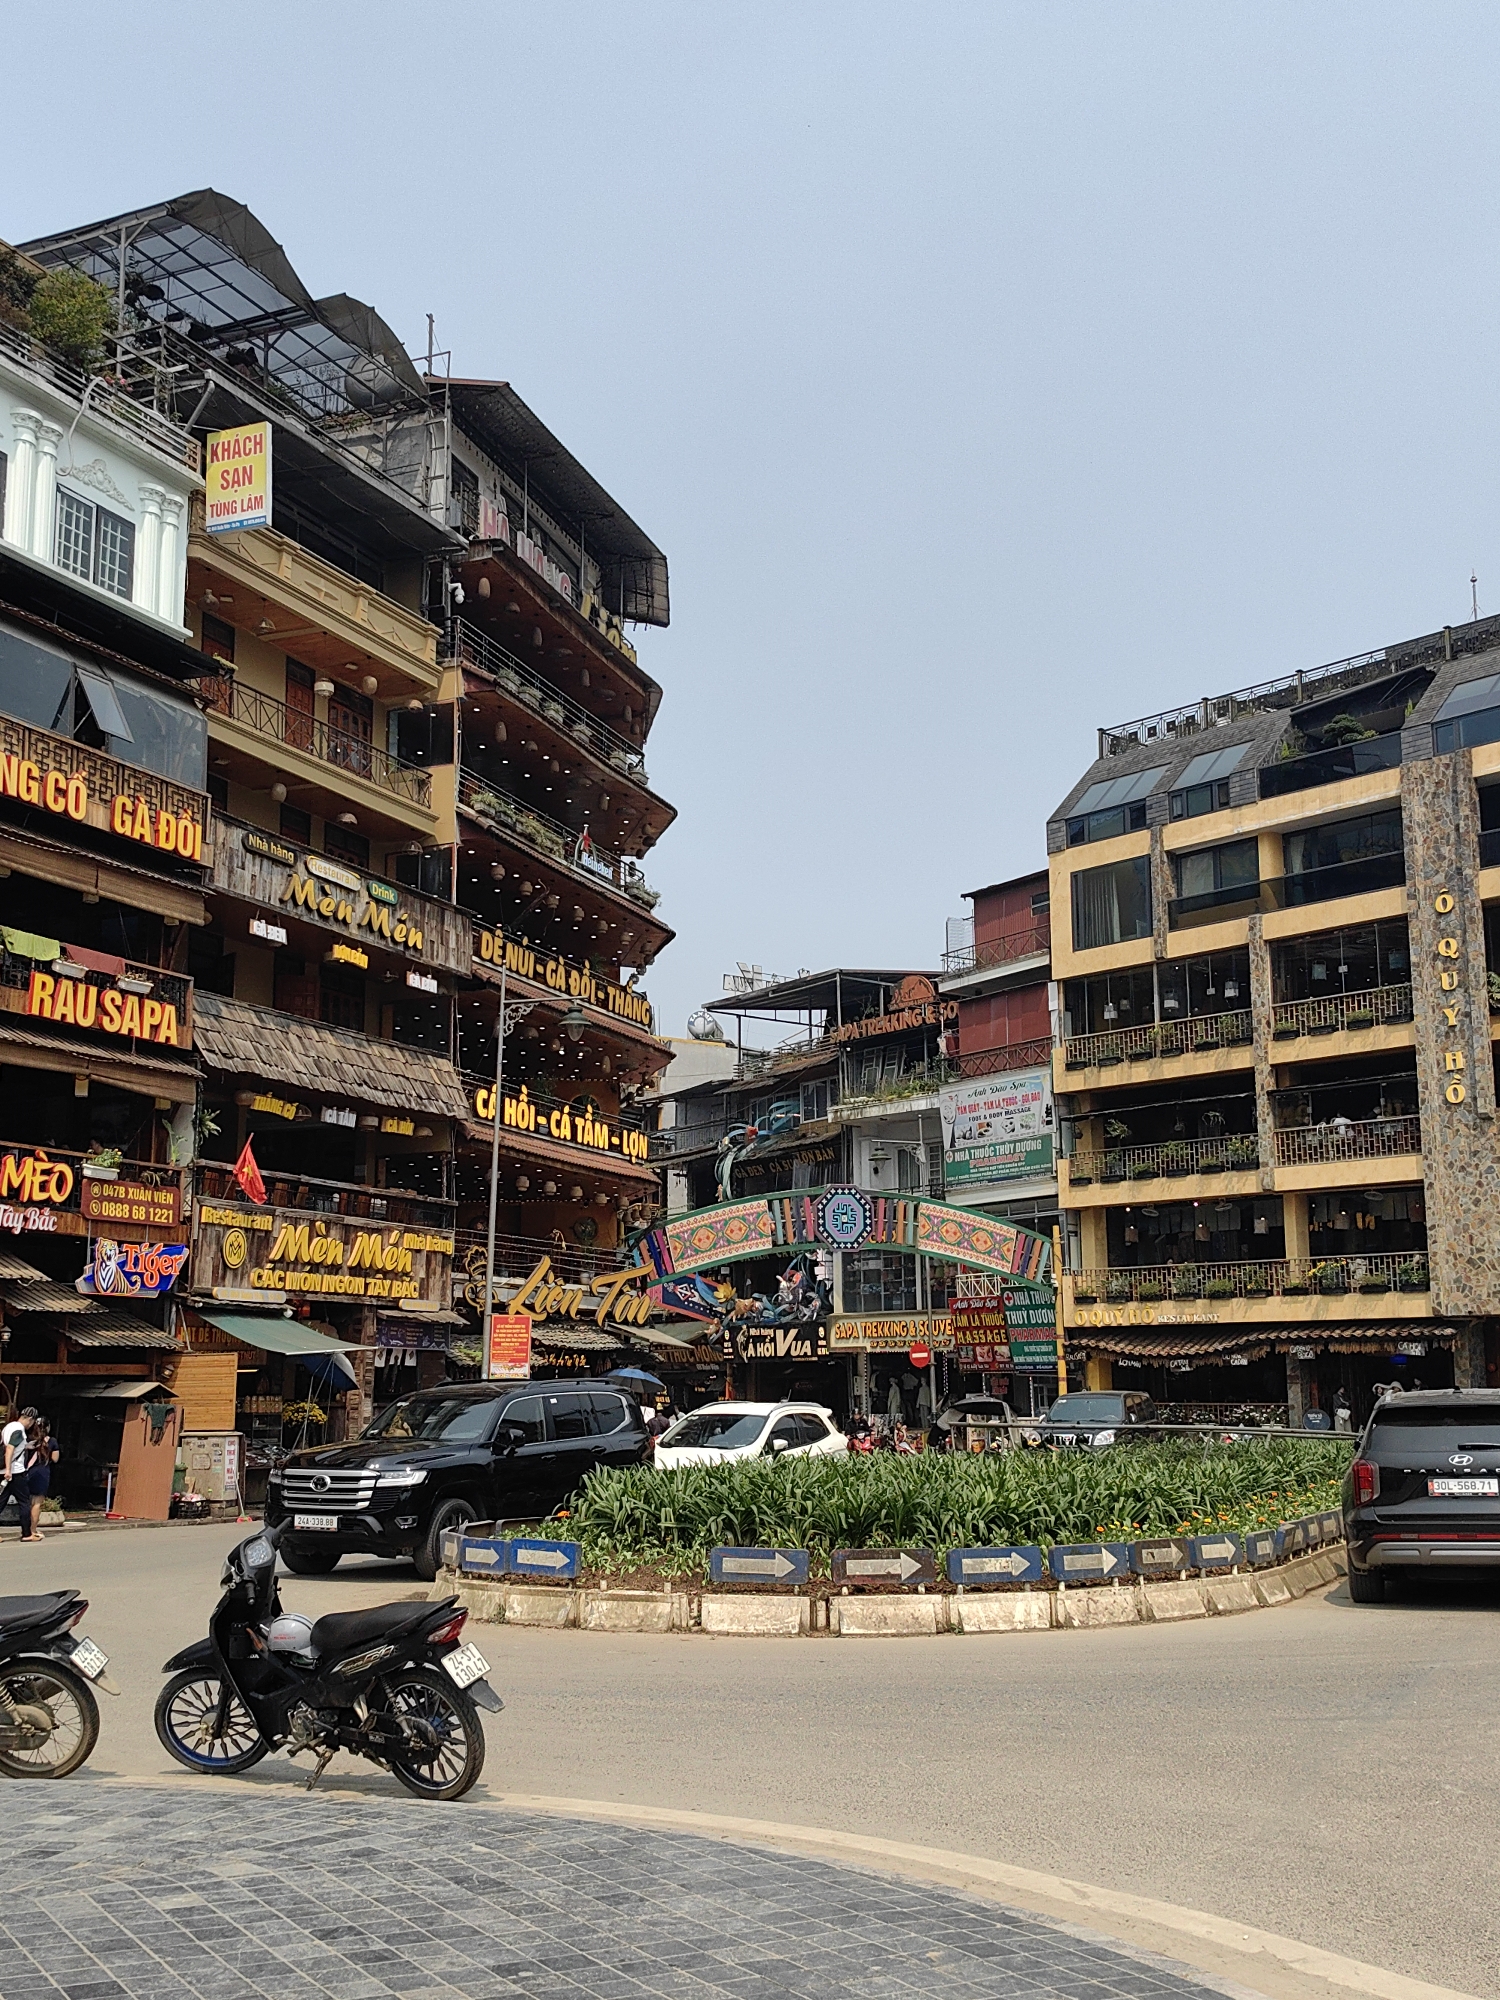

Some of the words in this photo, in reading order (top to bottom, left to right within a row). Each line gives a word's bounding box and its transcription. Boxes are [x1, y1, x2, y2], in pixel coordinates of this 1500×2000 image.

[210, 434, 263, 464] KHÁCH
[220, 465, 252, 493] SẠN
[210, 500, 238, 518] TÙNG
[240, 494, 264, 512] LÂM
[110, 795, 151, 844] GÀ
[154, 808, 202, 861] ĐỒI
[248, 834, 268, 852] Nhà
[270, 841, 295, 863] hàng
[310, 860, 360, 889] Restaurant
[372, 884, 396, 901] Drink
[1435, 888, 1454, 913] Ô
[280, 873, 352, 924] Mèn
[360, 901, 424, 950] Mén
[481, 929, 504, 964] DÊ
[506, 936, 534, 978] NÚI
[546, 956, 566, 991] GÀ
[569, 960, 596, 1004] ĐỒI
[1438, 937, 1460, 1026] QUÝ
[28, 971, 98, 1027] RAU
[99, 989, 178, 1045] SAPA
[830, 1022, 860, 1043] SAPA
[860, 1008, 922, 1037] TREKKING
[926, 1005, 936, 1024] &
[1010, 1081, 1026, 1091] Spa
[1444, 1050, 1466, 1104] HỒ
[476, 1083, 497, 1120] CÁ
[504, 1085, 535, 1131] HỒI
[550, 1105, 571, 1140] CÁ
[575, 1104, 609, 1150] TẦM
[623, 1130, 648, 1163] LỢN
[989, 1112, 1002, 1120] BODY
[1004, 1106, 1032, 1116] MASSAGE
[955, 1149, 970, 1162] NHÀ
[971, 1144, 994, 1159] THUỐC
[1016, 1140, 1042, 1152] DƯƠNG
[970, 1152, 1026, 1168] PHARMACY
[0, 1150, 74, 1202] MÈO
[102, 1186, 126, 1198] 047B
[128, 1187, 152, 1202] XUÂN
[153, 1190, 174, 1204] VIÊN
[0, 1204, 24, 1234] Tây
[26, 1208, 58, 1232] Bắc
[102, 1201, 129, 1218] 0888
[132, 1205, 146, 1220] 68
[149, 1208, 174, 1224] 1221
[201, 1206, 273, 1230] Restaurant
[270, 1222, 344, 1266] Mèn
[348, 1230, 413, 1274] Mén
[404, 1233, 426, 1250] Nhà
[426, 1234, 453, 1254] hàng
[122, 1242, 184, 1288] Tiger
[251, 1264, 285, 1288] CÁC
[285, 1266, 321, 1292] MÓN
[322, 1275, 364, 1294] NGON
[366, 1274, 390, 1297] TÂY
[392, 1272, 419, 1298] BẮC
[985, 1298, 998, 1308] Spa
[1014, 1289, 1030, 1306] NHÀ
[970, 1312, 980, 1326] LÁ
[982, 1310, 1004, 1326] THUỐC
[1029, 1308, 1056, 1324] DƯƠN
[1074, 1308, 1087, 1326] Ô
[1089, 1306, 1124, 1327] QUÝ
[1129, 1306, 1155, 1324] HỒ
[1158, 1313, 1220, 1324] RESTAURANT
[835, 1322, 858, 1338] SAPA
[860, 1321, 908, 1337] TREKKING
[909, 1320, 916, 1336] &
[919, 1319, 954, 1336] SOUVE
[957, 1330, 1008, 1344] MASSAGE
[1010, 1328, 1056, 1342] PHARMAC
[757, 1336, 774, 1357] HỒI
[1434, 1481, 1492, 1490] 30L-568.71
[297, 1516, 334, 1528] 24A-338.88
[448, 1646, 476, 1670] 24-S1
[455, 1657, 487, 1685] 130.47
